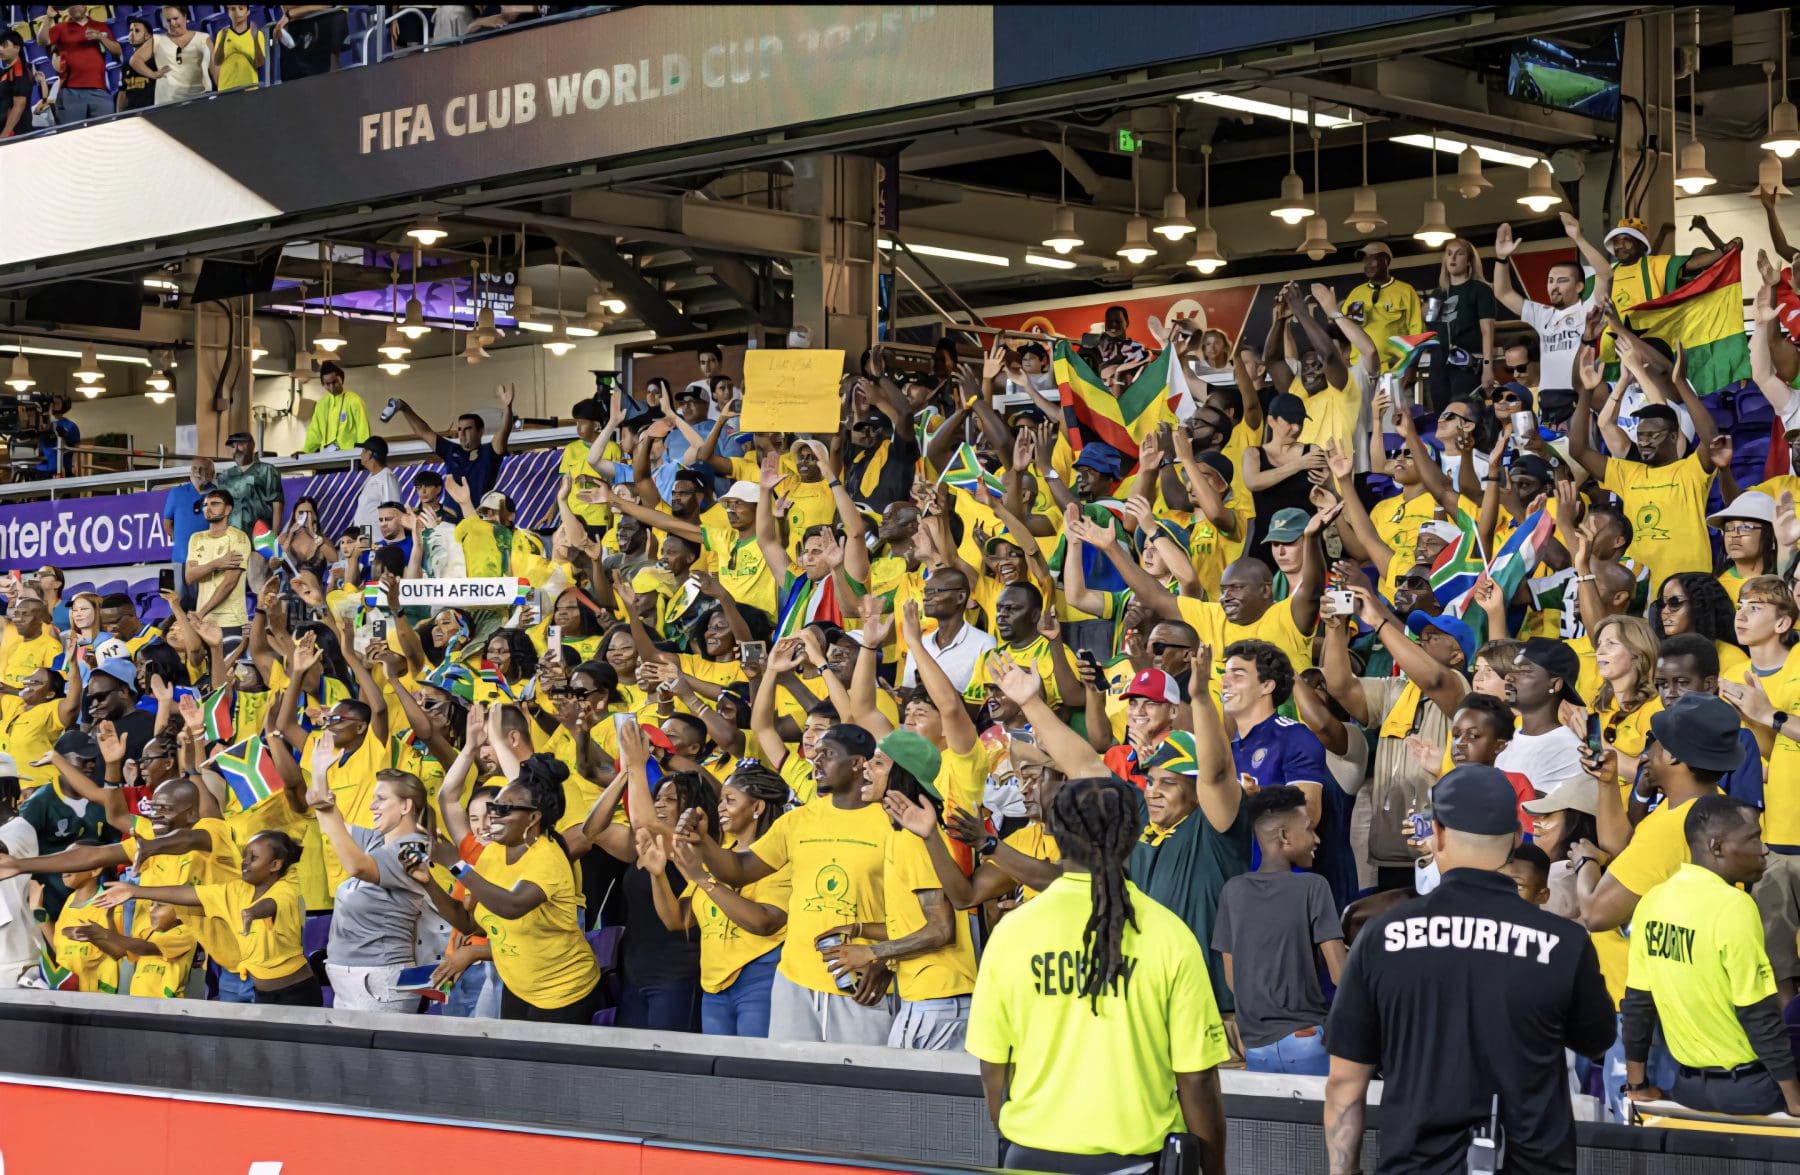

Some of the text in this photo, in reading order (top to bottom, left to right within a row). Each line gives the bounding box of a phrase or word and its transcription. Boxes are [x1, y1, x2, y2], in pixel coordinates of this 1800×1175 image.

[360, 104, 435, 154] FIFA
[445, 83, 536, 137] CLUB
[547, 53, 691, 117] WORLD
[701, 35, 784, 88] CUP
[118, 513, 175, 551] STA
[401, 584, 506, 597] OUTH AFRICA
[1384, 915, 1560, 965] SECURITY
